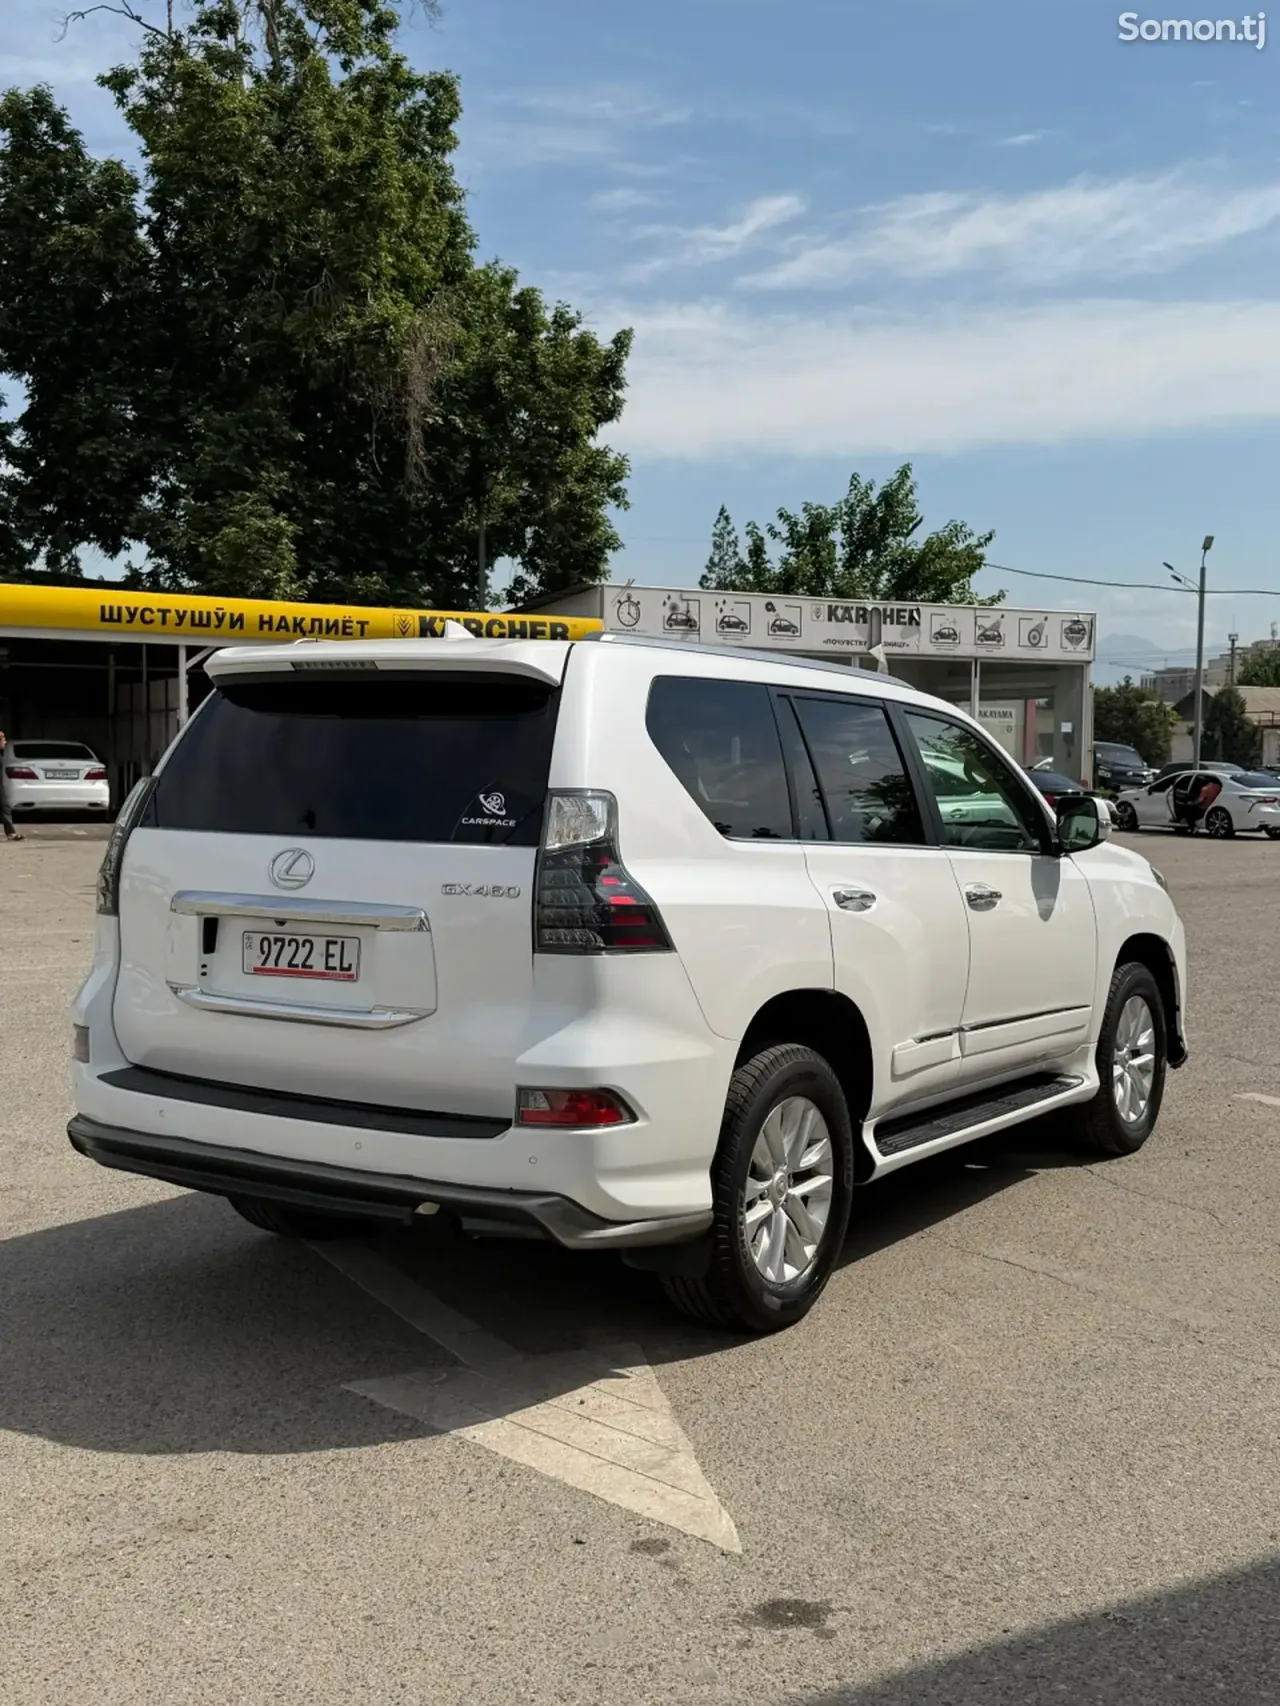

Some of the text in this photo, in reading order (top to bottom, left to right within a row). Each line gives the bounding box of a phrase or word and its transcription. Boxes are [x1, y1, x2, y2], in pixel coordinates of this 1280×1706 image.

[827, 604, 920, 626] KÄRHER
[259, 614, 370, 637] НАҚЛИЁТ
[979, 709, 1013, 719] AKAYAMA
[461, 817, 516, 827] CARSPACE
[441, 883, 521, 899] GX460
[259, 936, 353, 972] 9722 EL
